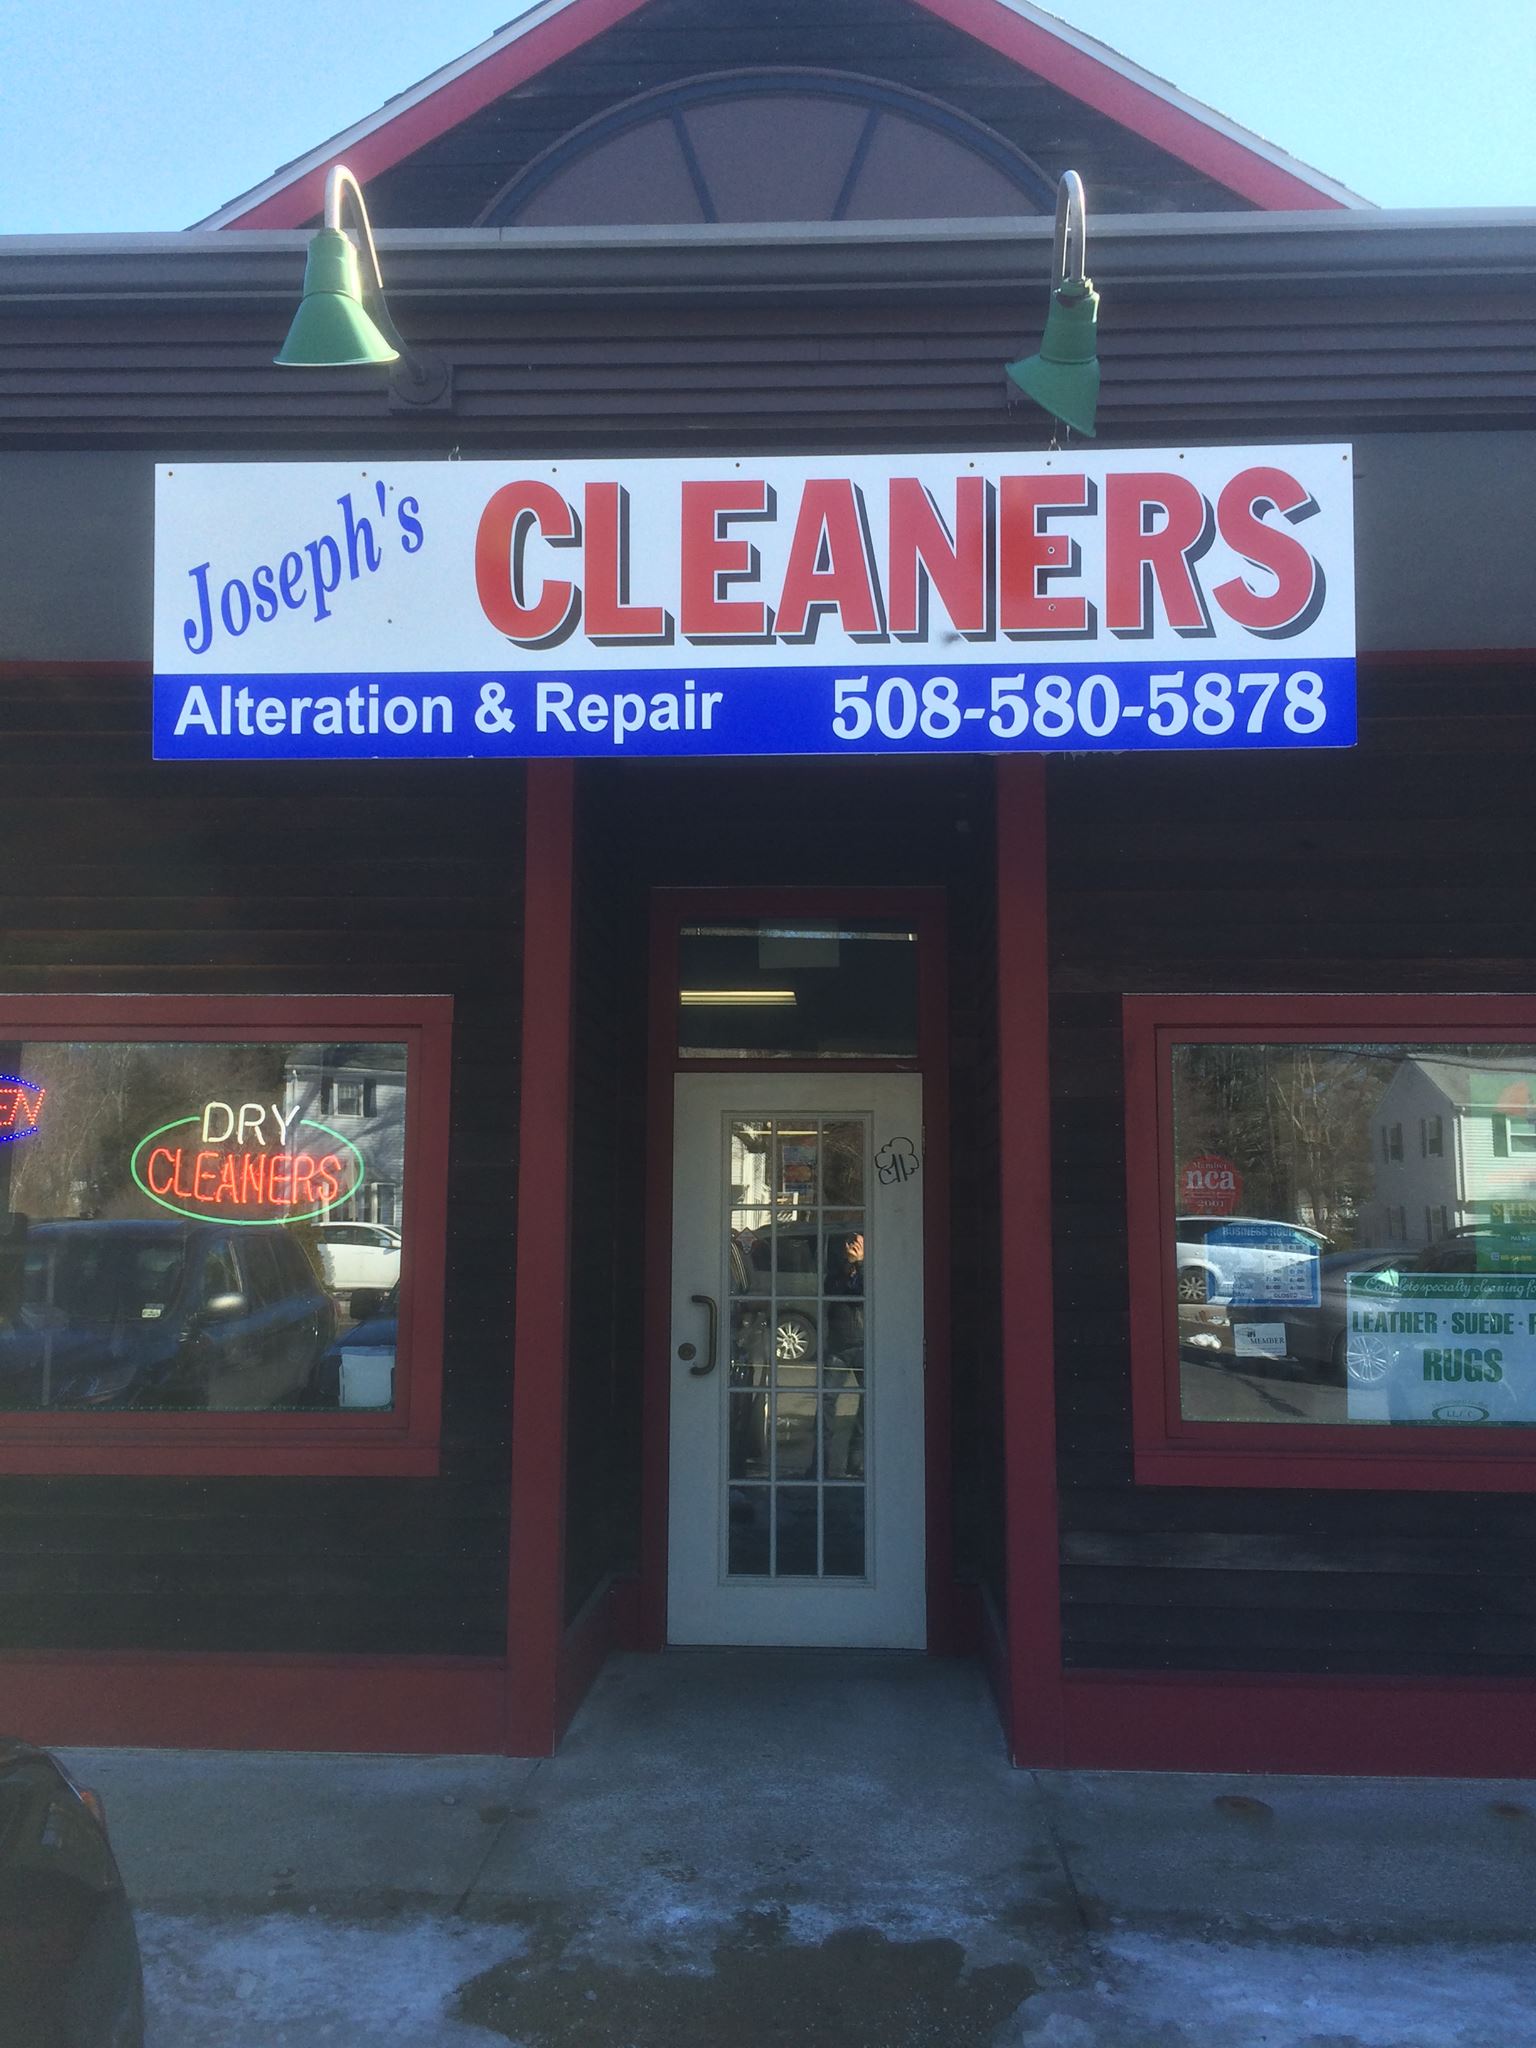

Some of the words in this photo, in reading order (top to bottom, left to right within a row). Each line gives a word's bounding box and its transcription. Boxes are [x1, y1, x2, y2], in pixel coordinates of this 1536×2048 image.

[183, 480, 424, 655] Joseph's
[475, 466, 1326, 651] CLEANERS
[173, 684, 454, 736] Alteration
[473, 681, 516, 736] &
[536, 679, 724, 745] Repair
[831, 670, 1327, 741] 508-580-5878
[201, 1100, 301, 1146] DRY
[147, 1147, 343, 1205] CLEANERS
[1185, 1170, 1236, 1190] nca
[1473, 1279, 1524, 1298] cleaning
[1352, 1311, 1438, 1334] LEATHER
[1451, 1312, 1515, 1335] SUEDE
[1423, 1348, 1503, 1383] RUGS
